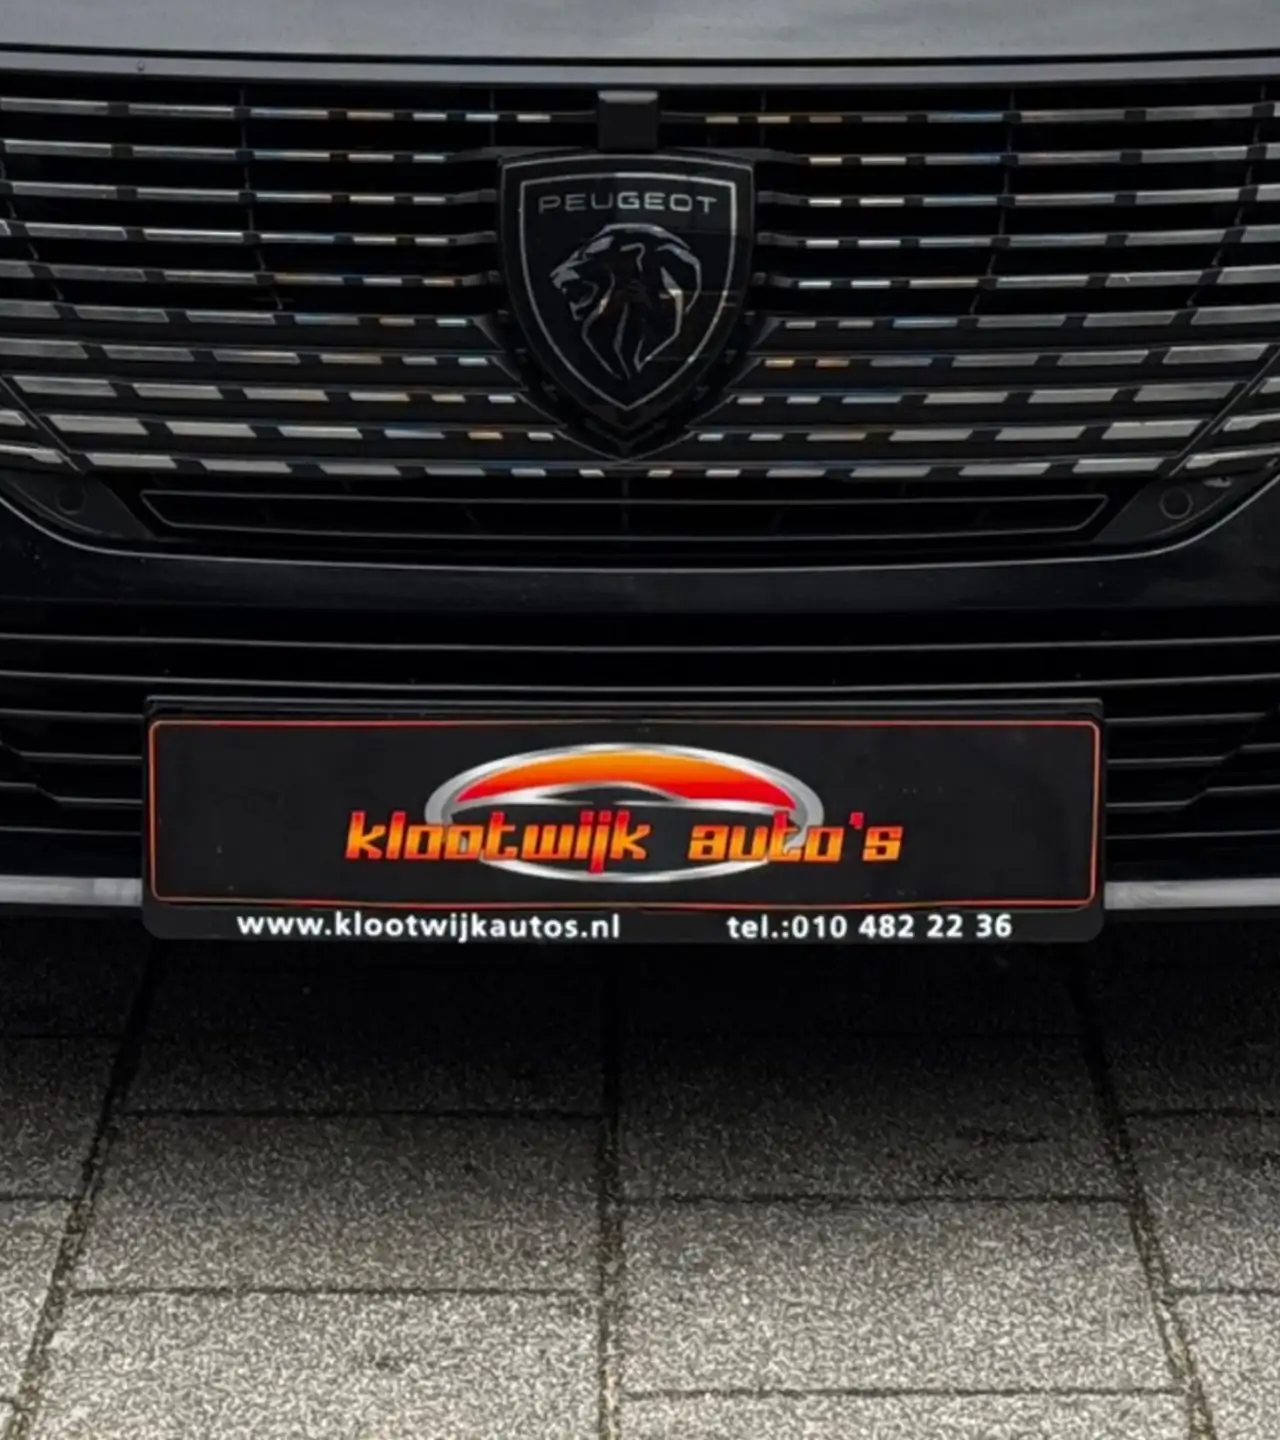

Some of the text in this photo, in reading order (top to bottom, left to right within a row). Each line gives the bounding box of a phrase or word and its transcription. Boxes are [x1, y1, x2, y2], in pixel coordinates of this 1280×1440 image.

[538, 191, 718, 214] PEUGEOT
[345, 810, 904, 874] klootwijk auto's
[236, 911, 620, 943] www.klootwijkautos.nl
[726, 914, 1012, 939] tel.:010 482 22 36
